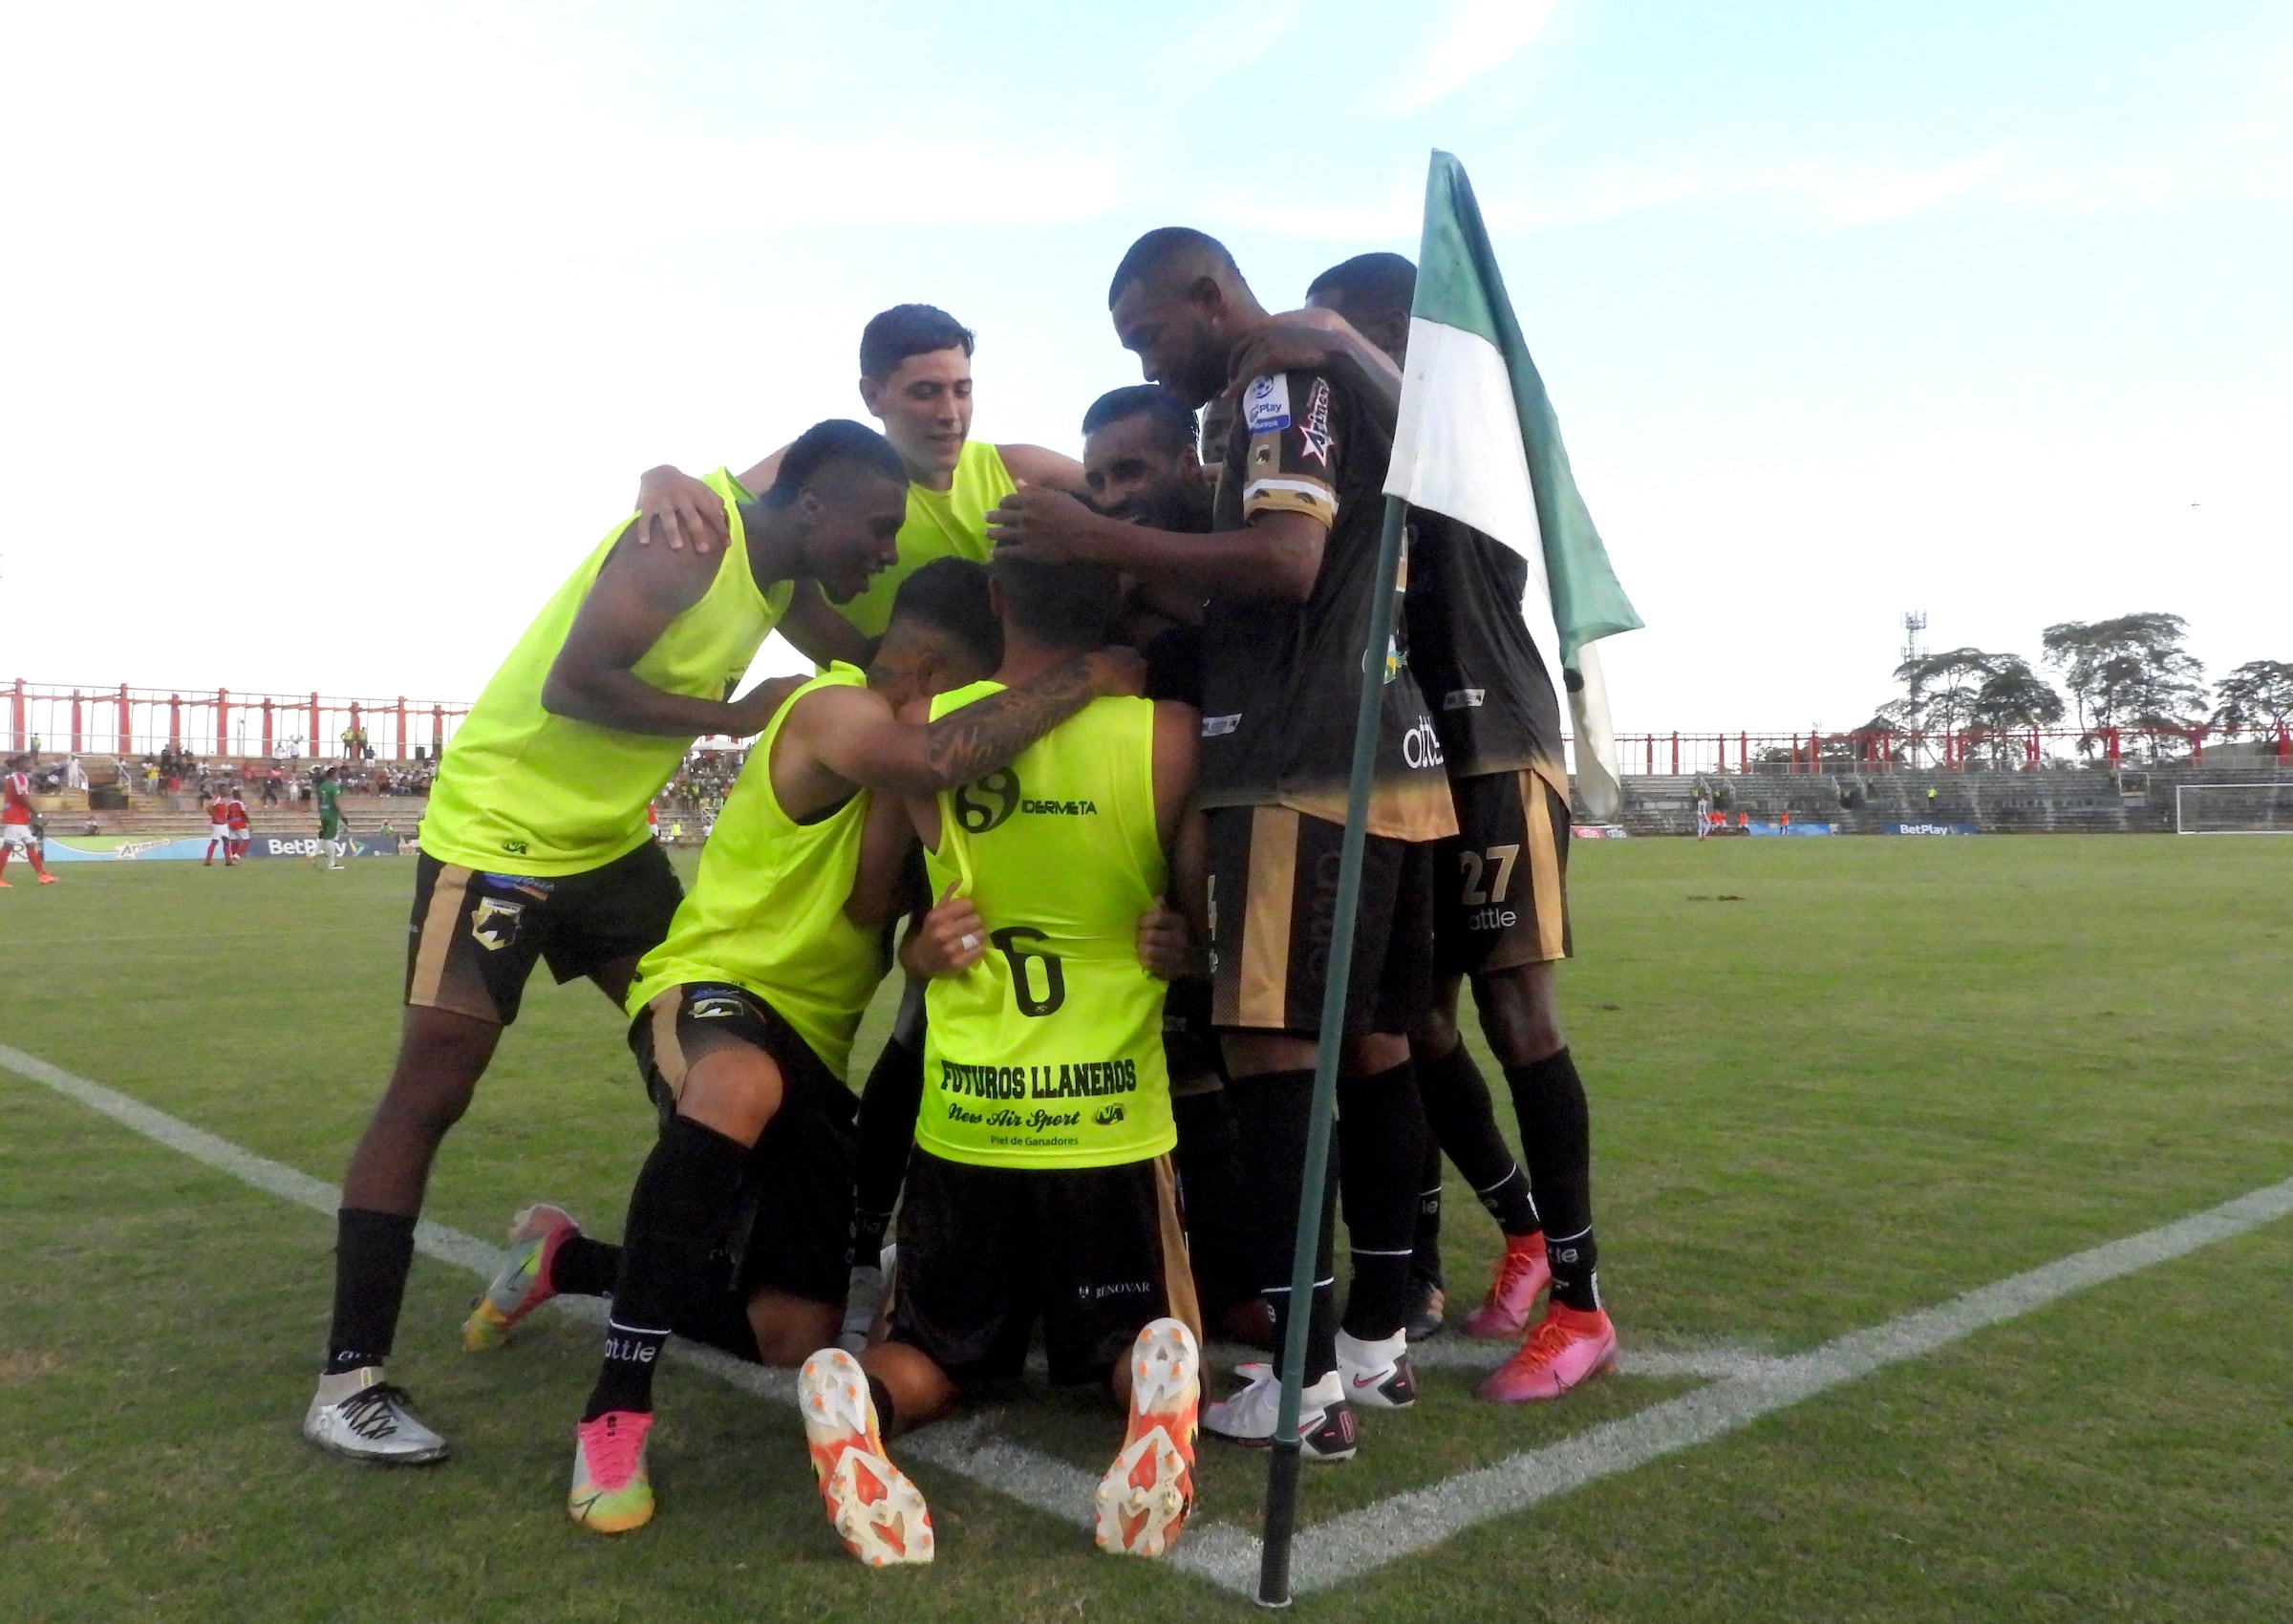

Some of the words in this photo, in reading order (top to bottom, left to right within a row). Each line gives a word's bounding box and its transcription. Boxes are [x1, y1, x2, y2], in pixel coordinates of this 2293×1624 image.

[1899, 823, 1948, 836] BetPlay
[268, 839, 347, 857] BetPy
[1458, 844, 1520, 906] 27
[991, 926, 1065, 1017] 6
[940, 1059, 1025, 1099] FUTUROS
[1031, 1058, 1137, 1099] LLANEROS
[948, 1102, 982, 1124] New
[986, 1109, 1022, 1126] Air
[1026, 1109, 1081, 1133] Sport
[990, 1135, 1009, 1145] Piel
[1010, 1136, 1023, 1145] de
[1024, 1136, 1080, 1146] Ganadores
[1096, 1282, 1150, 1299] RENOVAR
